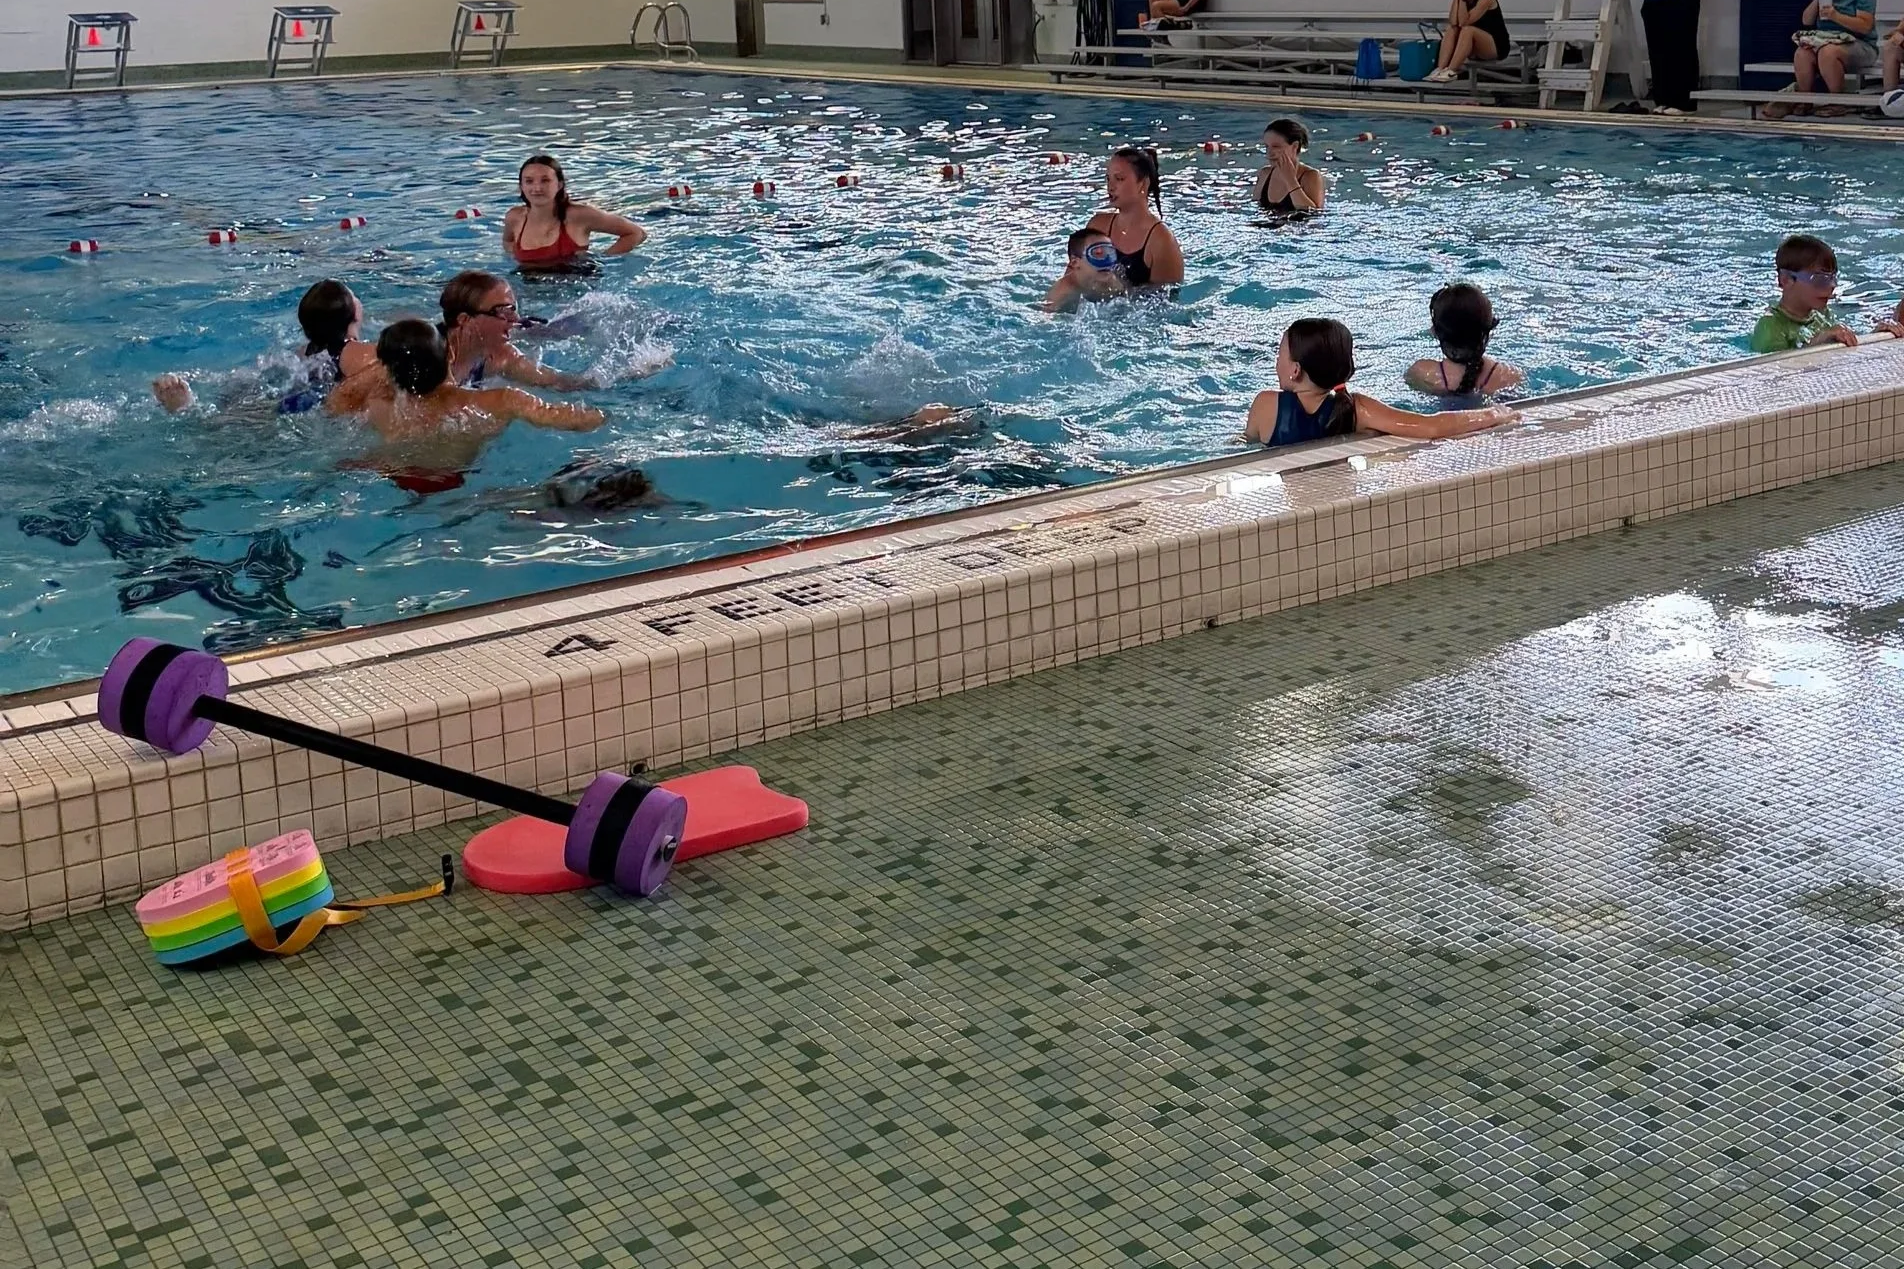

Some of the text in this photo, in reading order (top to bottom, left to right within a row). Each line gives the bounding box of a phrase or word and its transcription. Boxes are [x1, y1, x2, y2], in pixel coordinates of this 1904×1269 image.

[543, 516, 1148, 658] 4 FEET DEEP
